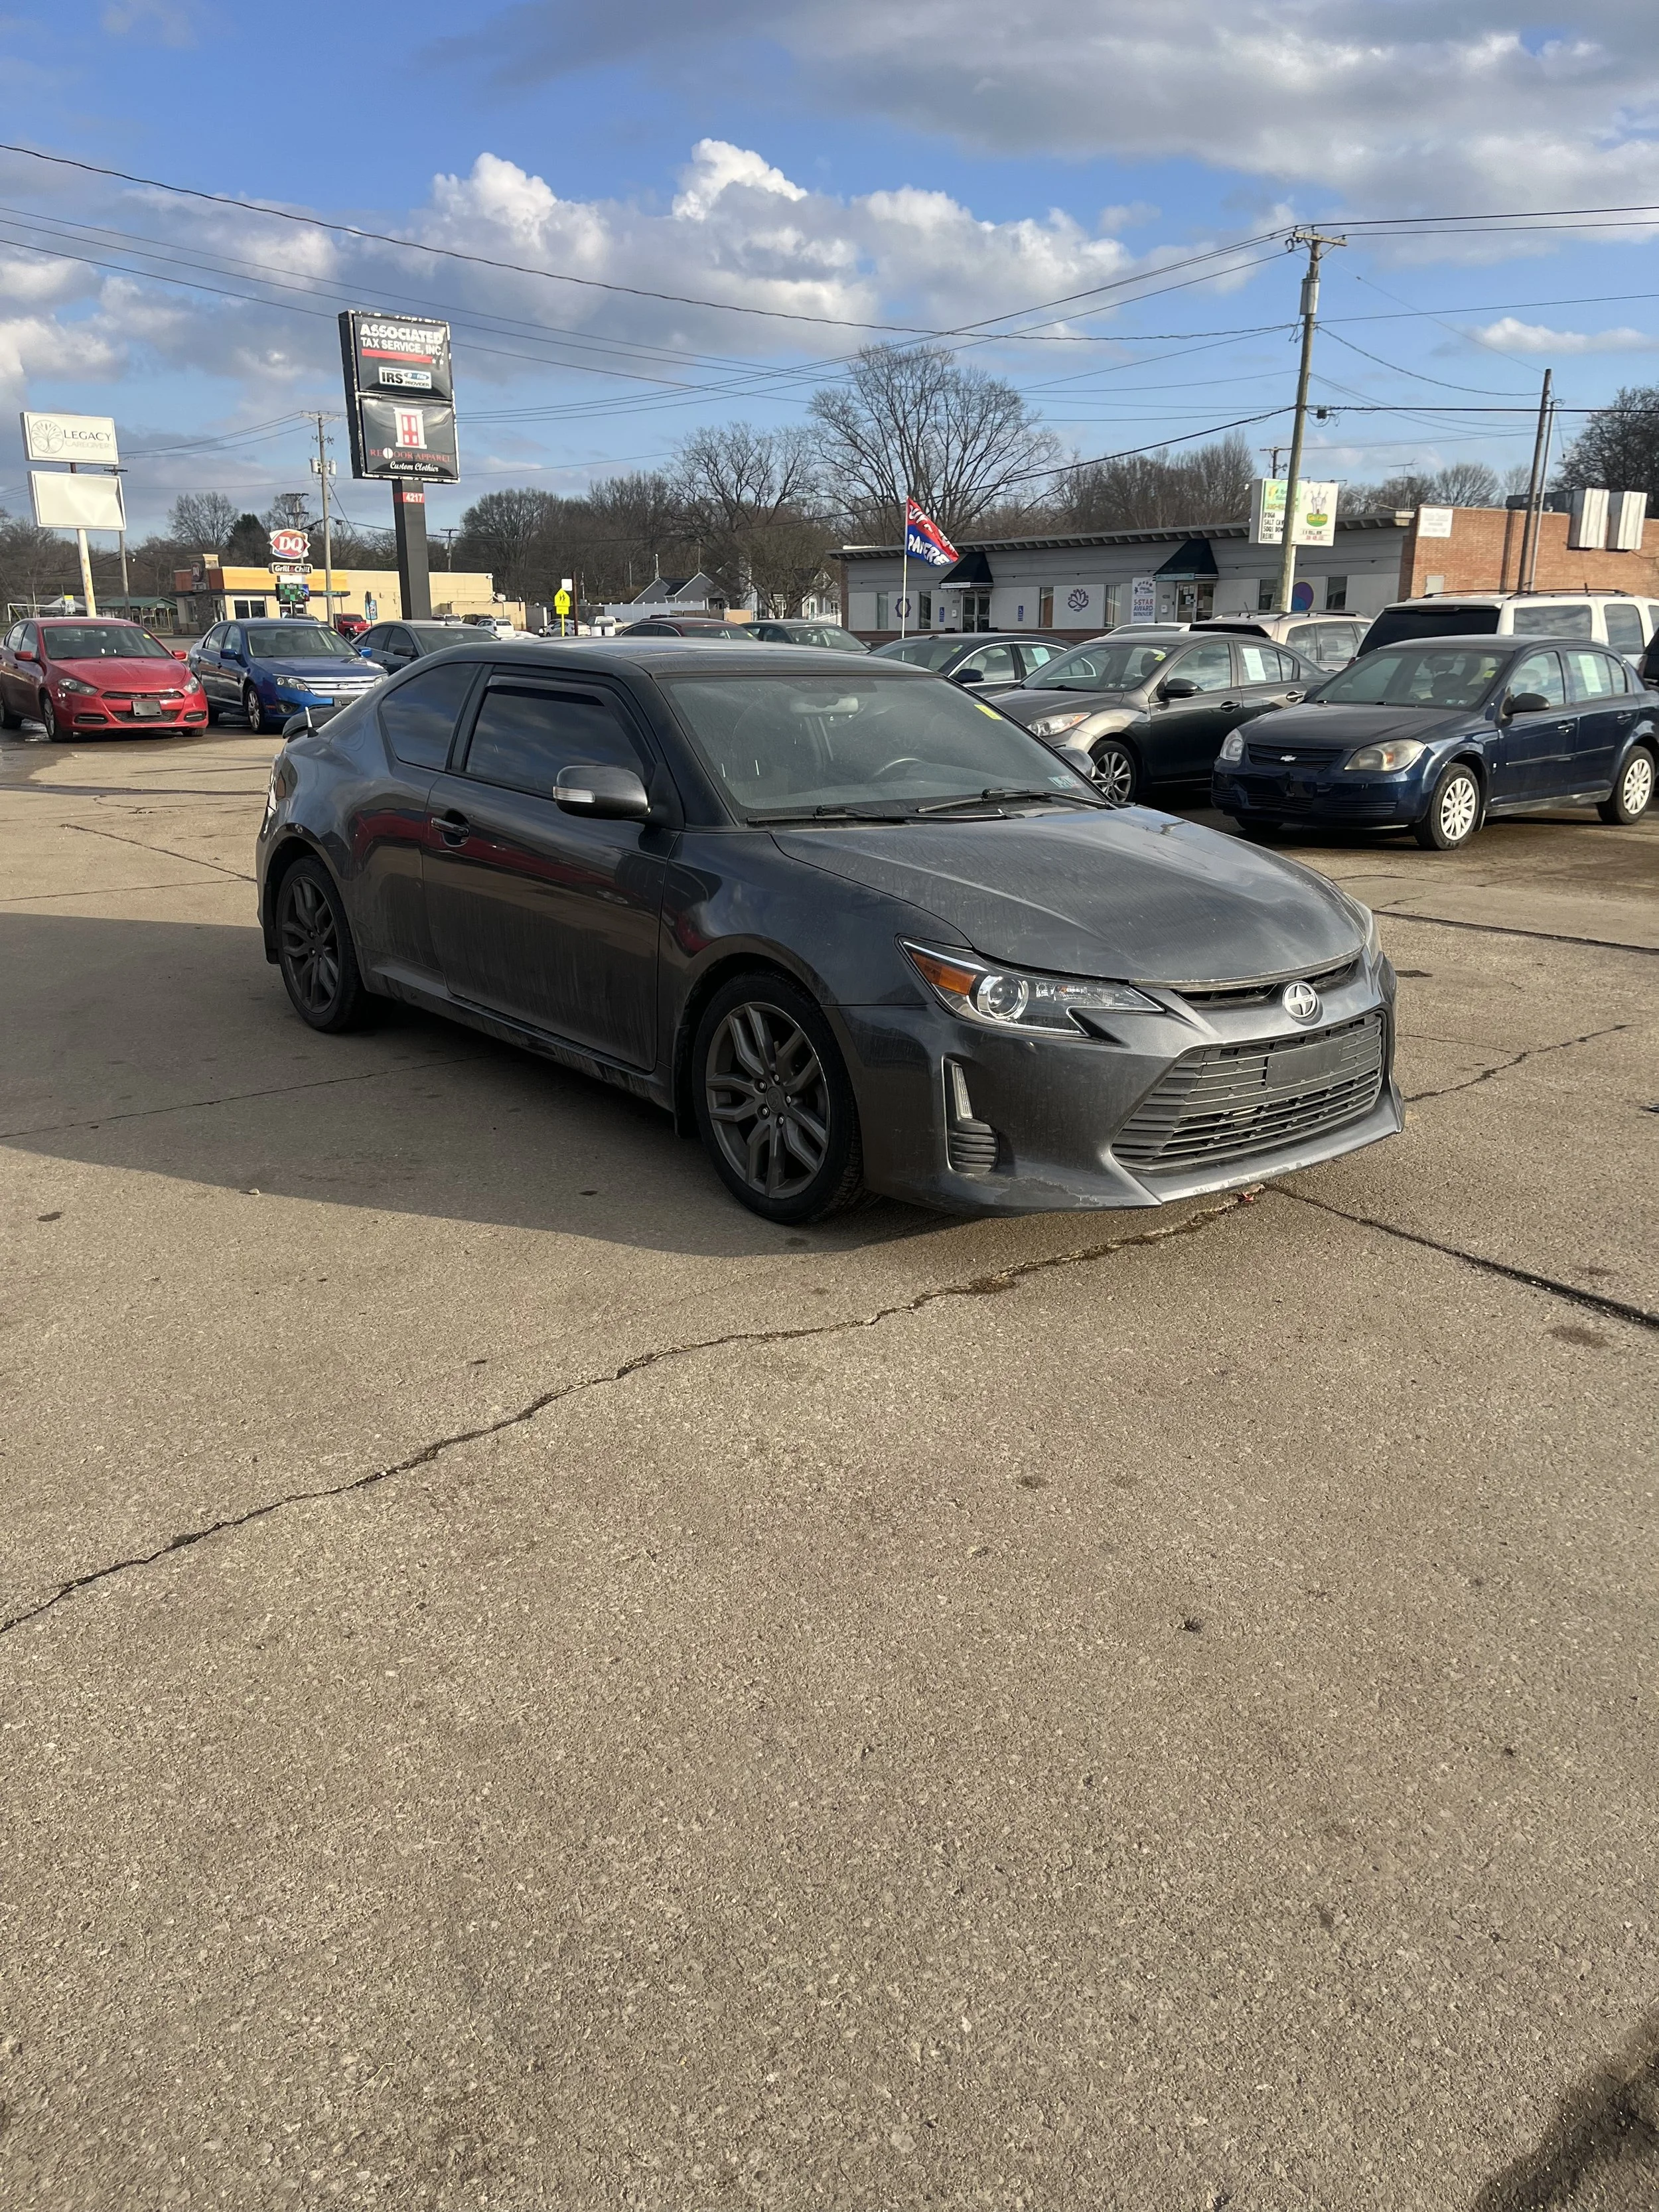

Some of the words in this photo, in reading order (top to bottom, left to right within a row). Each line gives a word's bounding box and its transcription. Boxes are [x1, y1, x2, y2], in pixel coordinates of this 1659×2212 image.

[360, 323, 443, 344] ASSOCIATED
[360, 336, 380, 348] TAX
[381, 339, 424, 355] SERVICE,
[425, 344, 444, 356] INC.
[382, 372, 403, 384] IRS
[64, 429, 111, 441] LEGACY
[415, 453, 453, 463] APPAREL
[390, 461, 413, 471] Custom
[414, 462, 439, 472] Clothier
[405, 492, 423, 502] 4217
[279, 536, 304, 553] DQ
